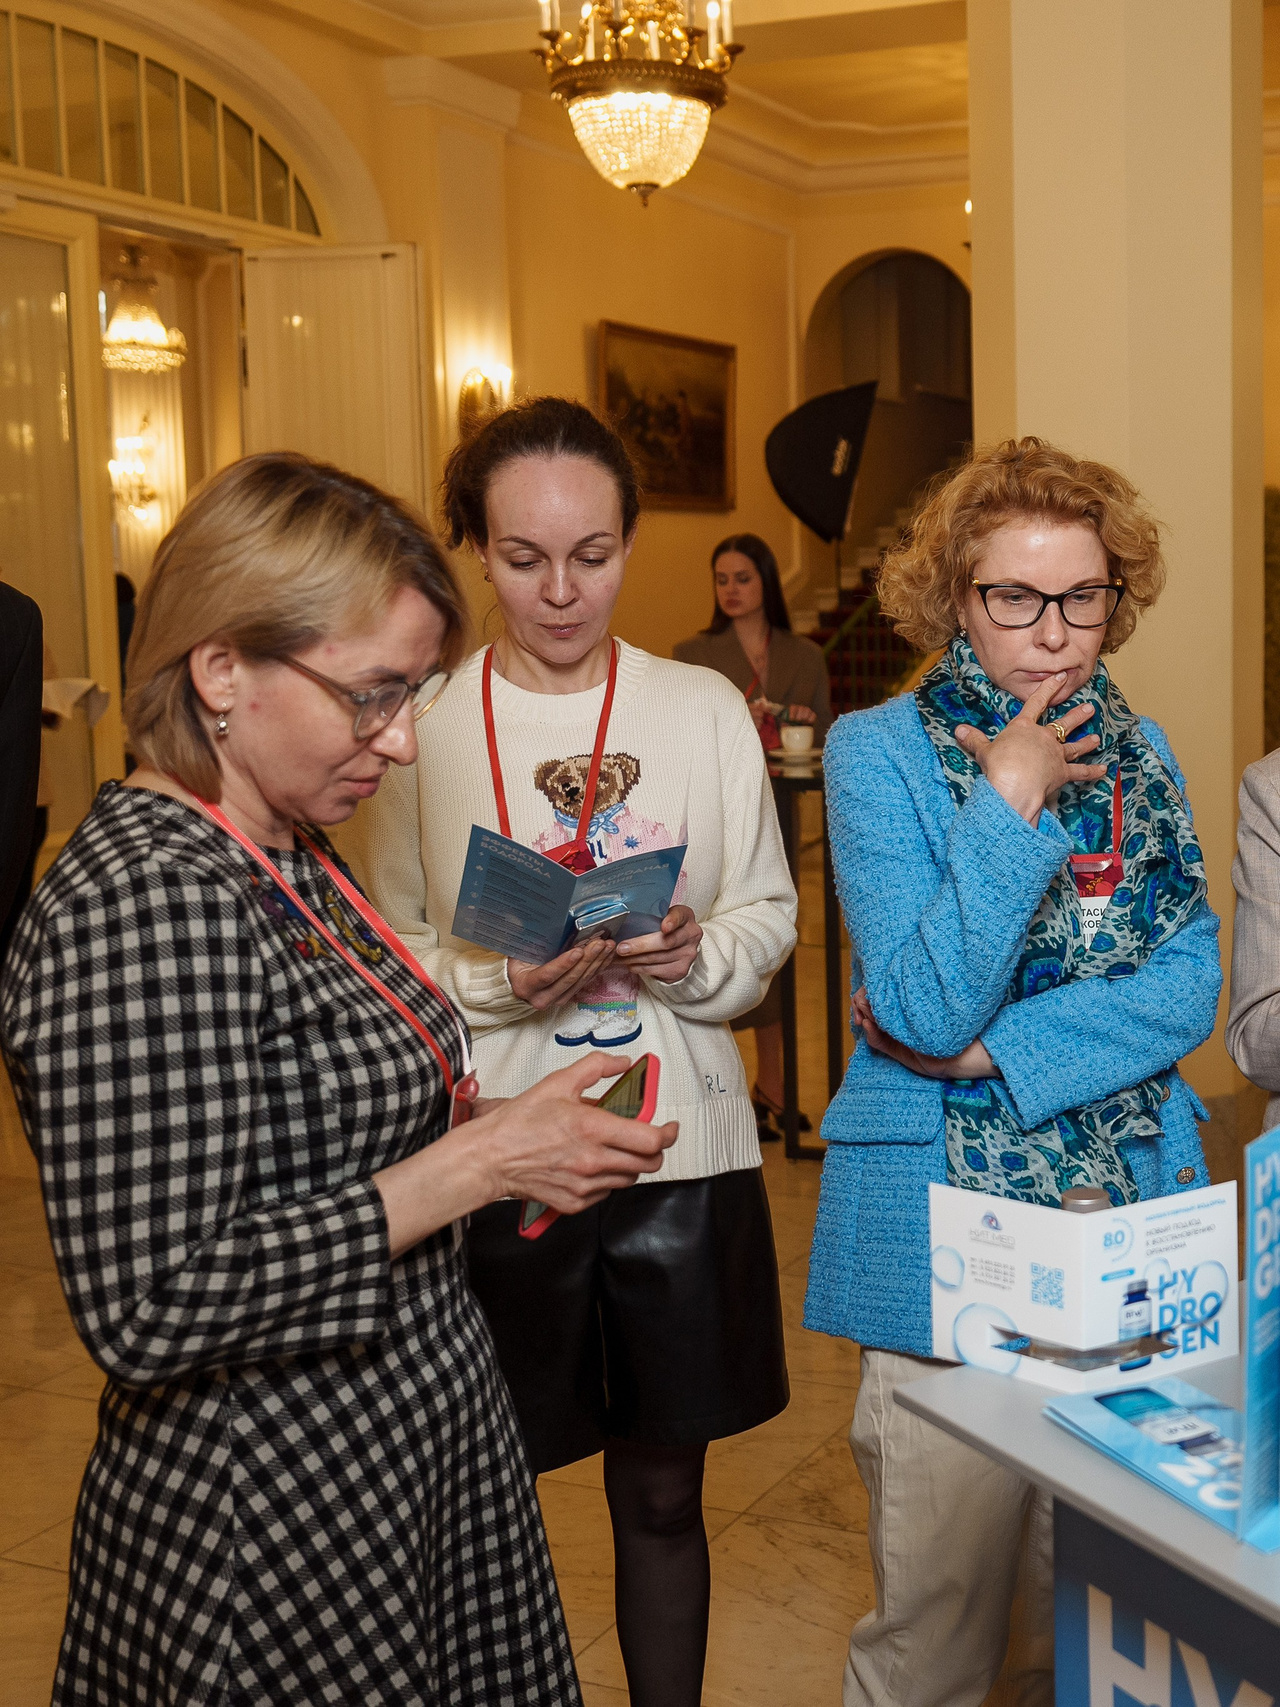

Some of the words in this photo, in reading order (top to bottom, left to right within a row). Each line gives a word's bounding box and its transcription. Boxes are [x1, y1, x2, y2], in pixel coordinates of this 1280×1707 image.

[480, 841, 552, 879] ВОДОРОДА
[481, 834, 545, 868] ЭФФЕКТЫ
[1158, 1265, 1199, 1300] HY
[1158, 1290, 1223, 1332] DRO
